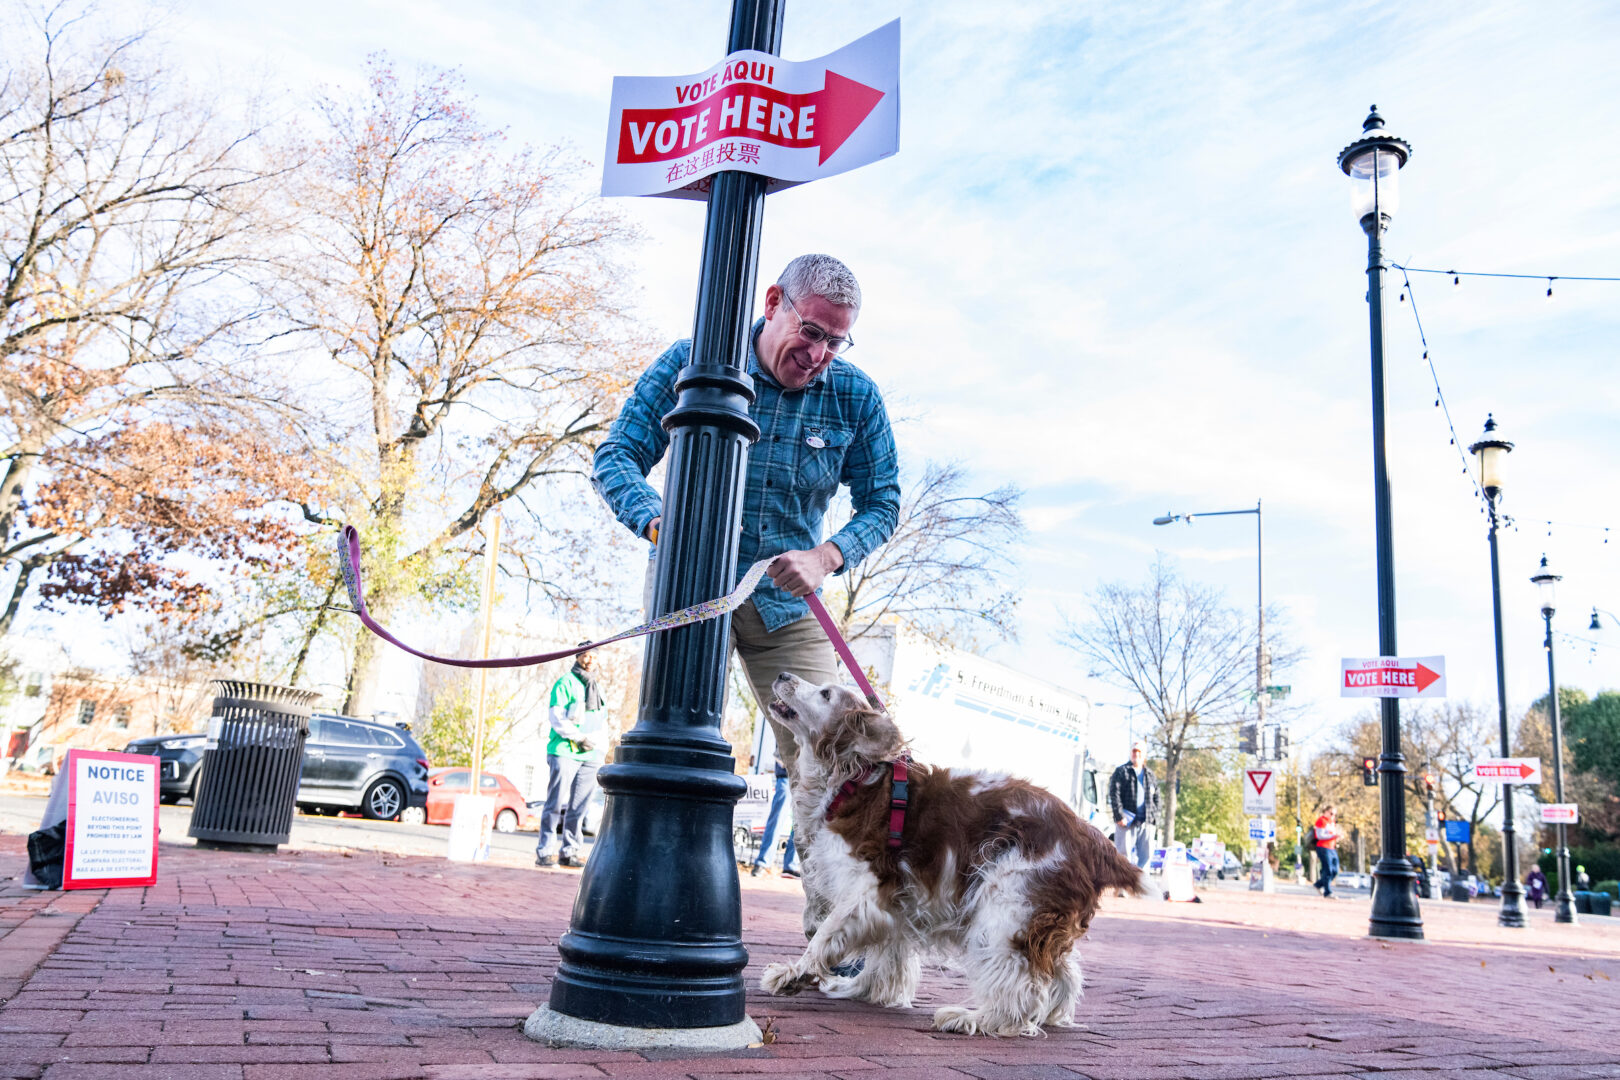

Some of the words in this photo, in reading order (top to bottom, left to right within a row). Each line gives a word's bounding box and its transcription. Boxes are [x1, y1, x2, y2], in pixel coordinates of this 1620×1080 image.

[675, 72, 719, 105] VOTE
[721, 60, 775, 86] AQUI
[628, 106, 711, 156] VOTE
[718, 95, 817, 140] HERE
[664, 142, 761, 185] 在这里投票
[1362, 660, 1378, 669] VOTE
[1380, 659, 1399, 667] AQUI
[1347, 672, 1378, 685] VOTE
[1382, 671, 1415, 685] HERE
[88, 765, 145, 782] NOTICE
[92, 790, 139, 805] AVISO
